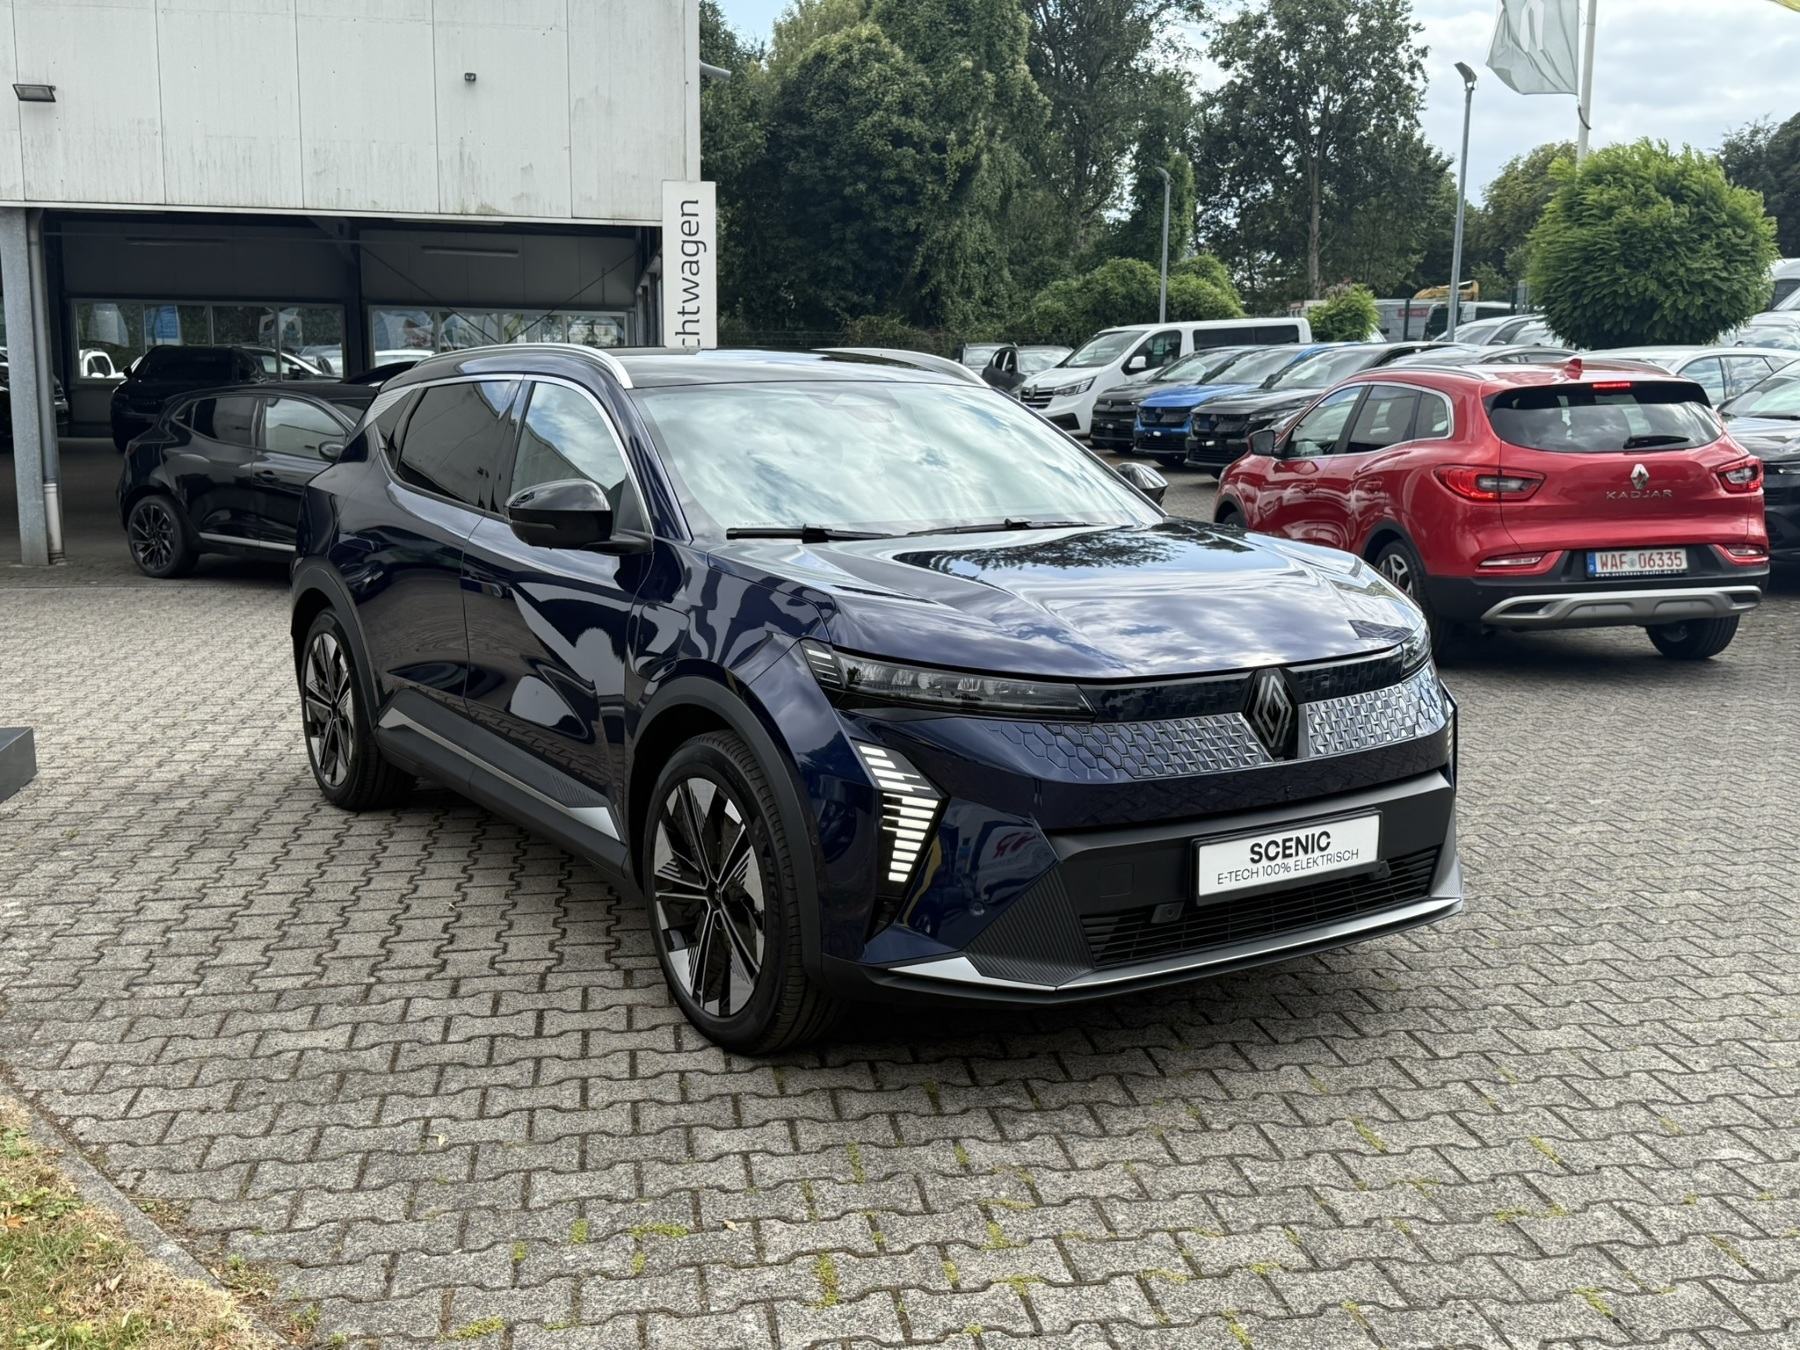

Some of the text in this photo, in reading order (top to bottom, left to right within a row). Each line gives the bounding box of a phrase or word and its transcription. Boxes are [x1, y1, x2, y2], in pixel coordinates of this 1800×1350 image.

[1606, 489, 1673, 500] KADJAR
[1600, 551, 1683, 570] WAF 06335
[1250, 830, 1332, 864] SCENIC
[1217, 848, 1359, 885] E-TECH 100% ELEKTRISCH
